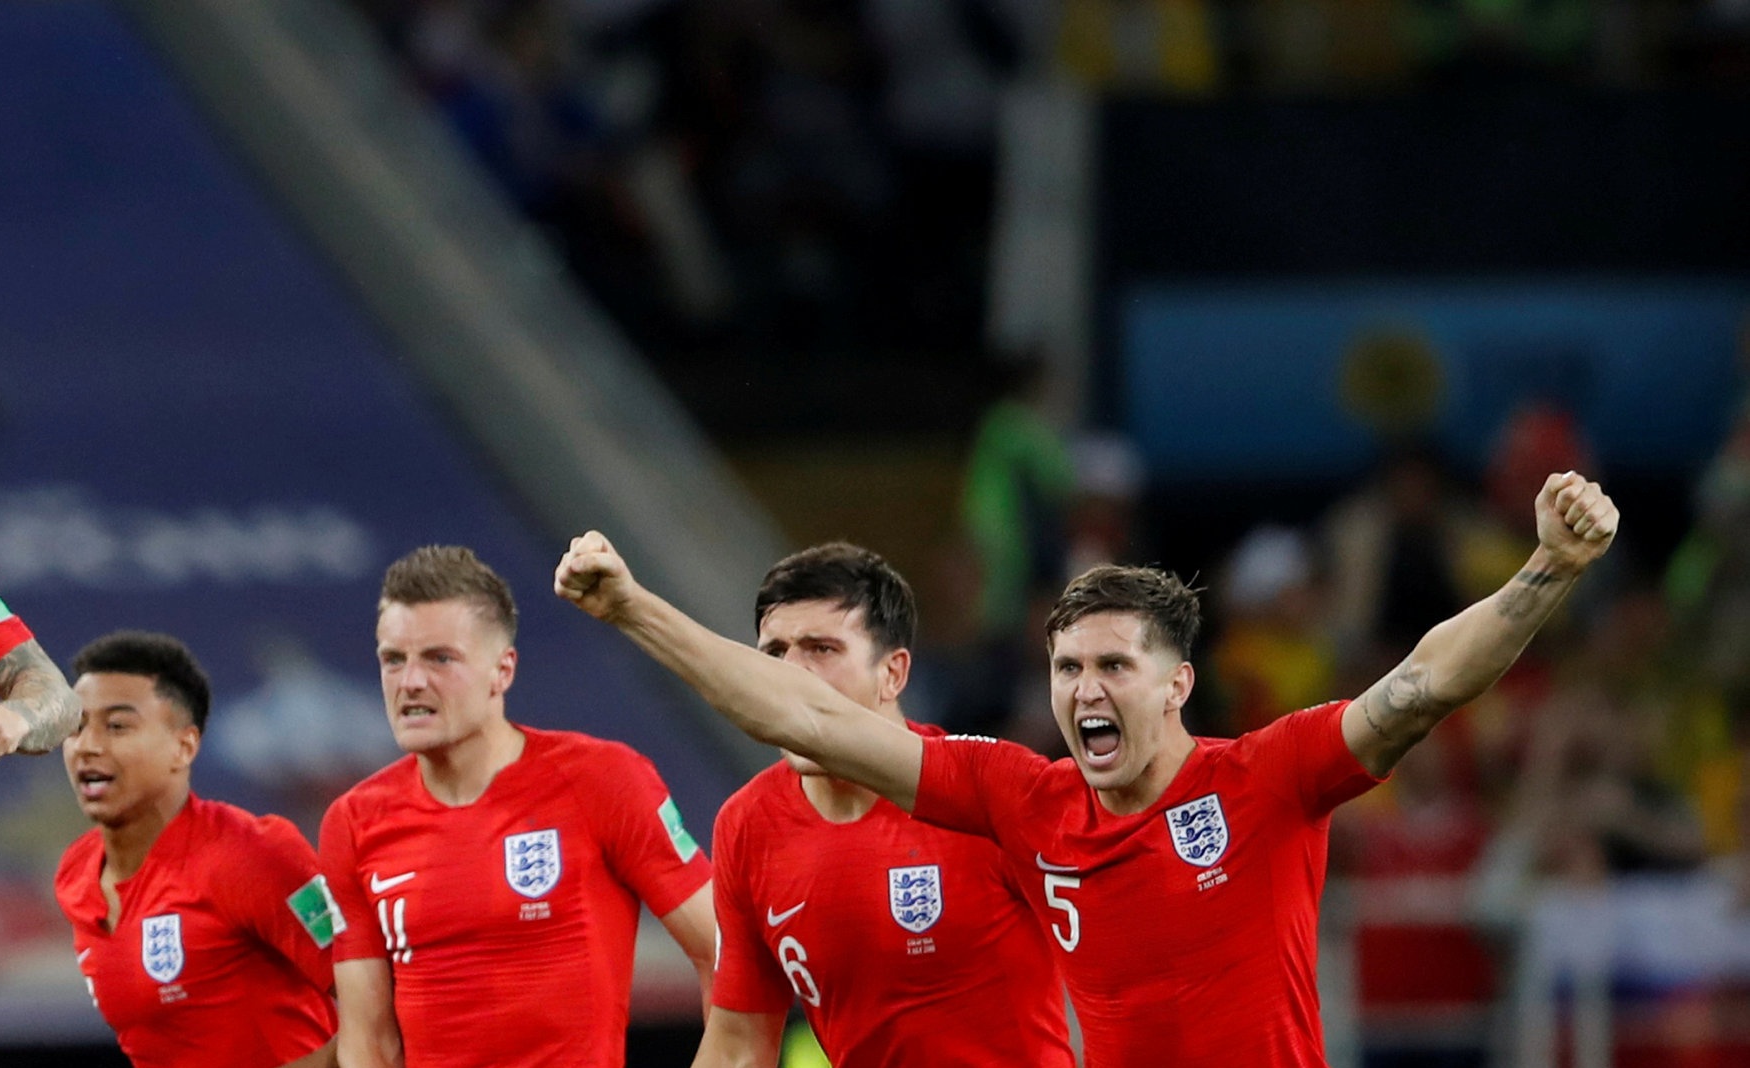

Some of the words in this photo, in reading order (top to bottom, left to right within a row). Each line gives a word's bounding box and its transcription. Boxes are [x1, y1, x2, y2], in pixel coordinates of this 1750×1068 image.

[377, 897, 413, 964] 11
[1044, 873, 1080, 953] 5
[777, 935, 820, 1008] 6
